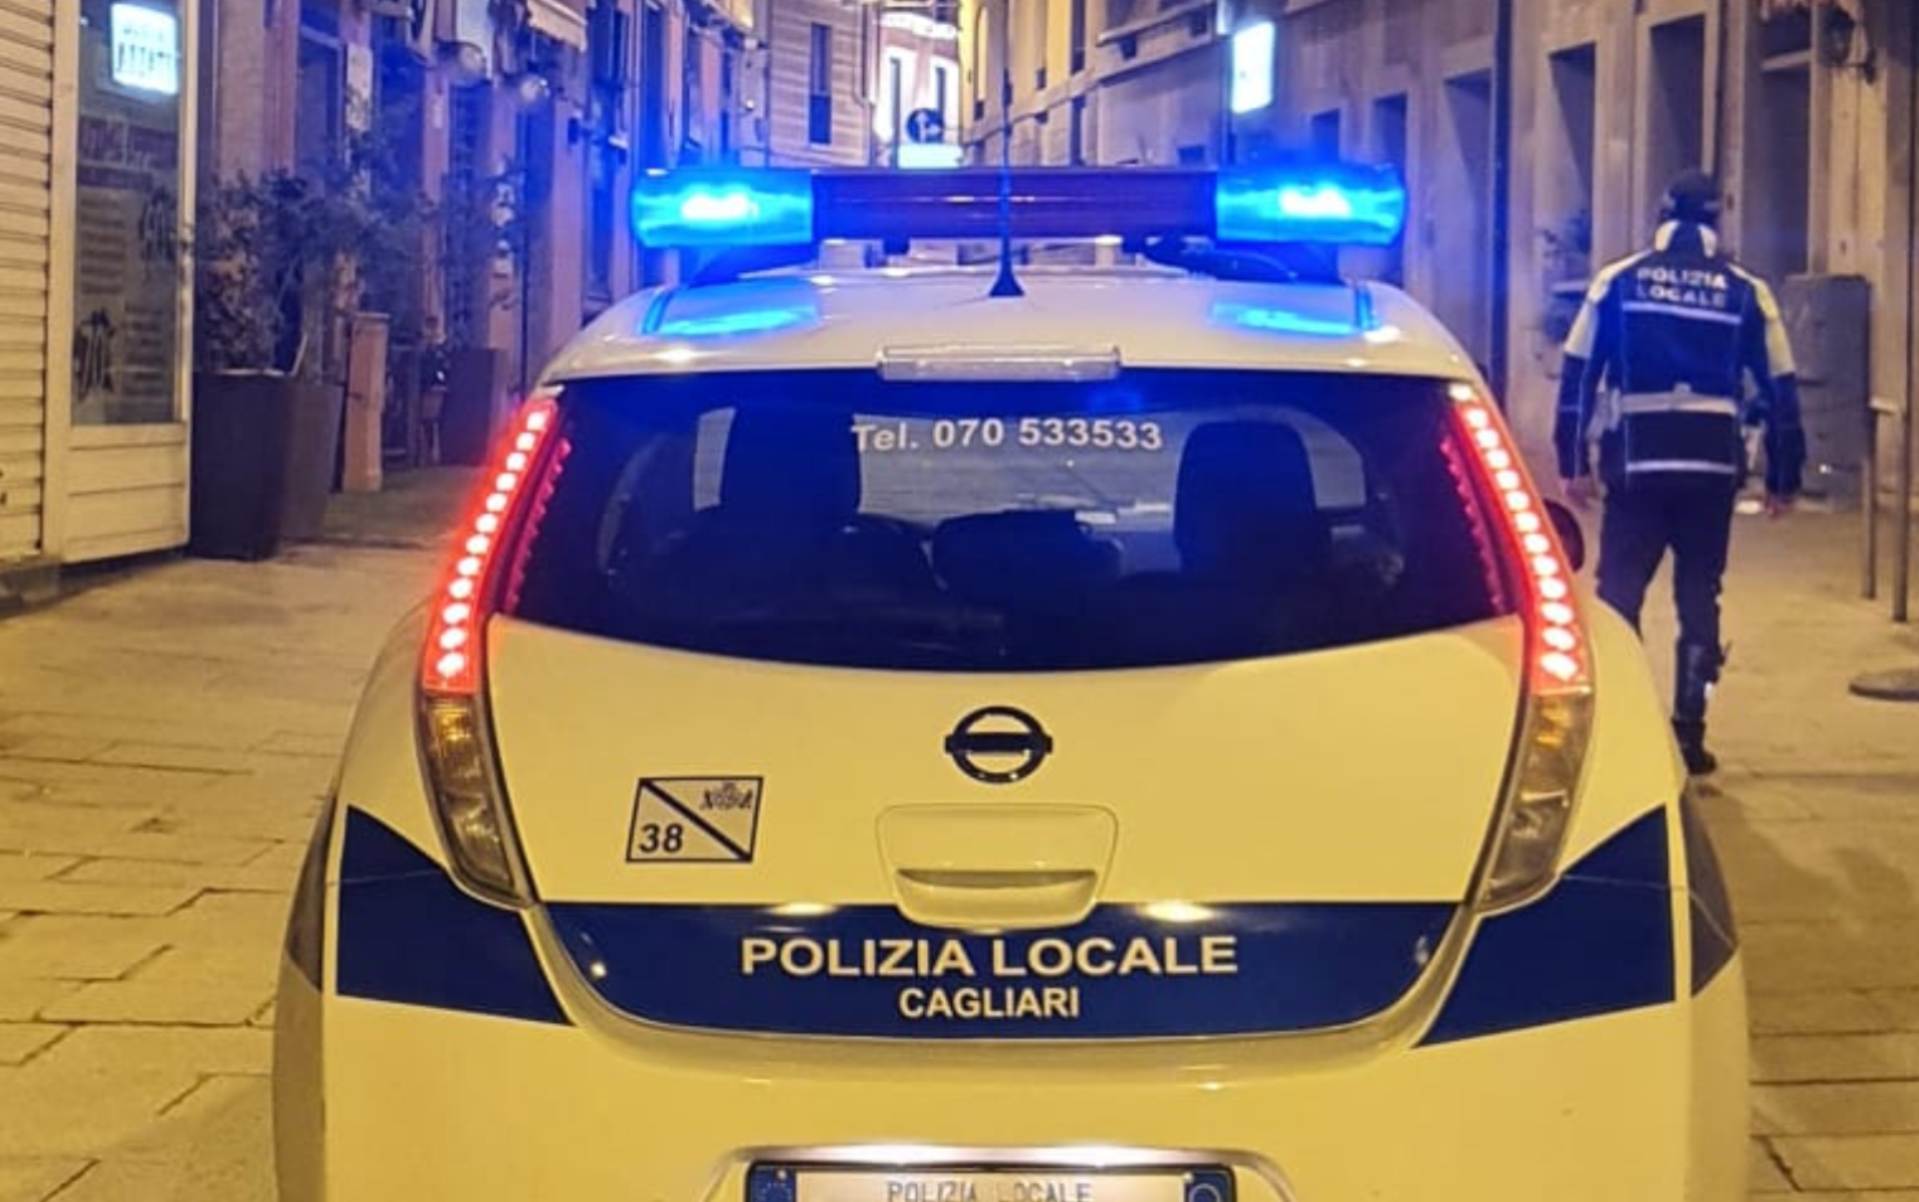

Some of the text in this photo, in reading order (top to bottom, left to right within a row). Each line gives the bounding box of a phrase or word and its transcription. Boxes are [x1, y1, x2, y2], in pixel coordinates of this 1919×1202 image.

[1637, 266, 1728, 291] POLIZIA
[1636, 284, 1727, 309] LOCALE
[851, 417, 1163, 453] Tel. 070 533533
[638, 823, 683, 853] 38
[741, 936, 1239, 977] POLIZIA LOCALE
[899, 987, 1081, 1019] CAGLIARI
[886, 1180, 1091, 1202] POLIZIA LOCALE
